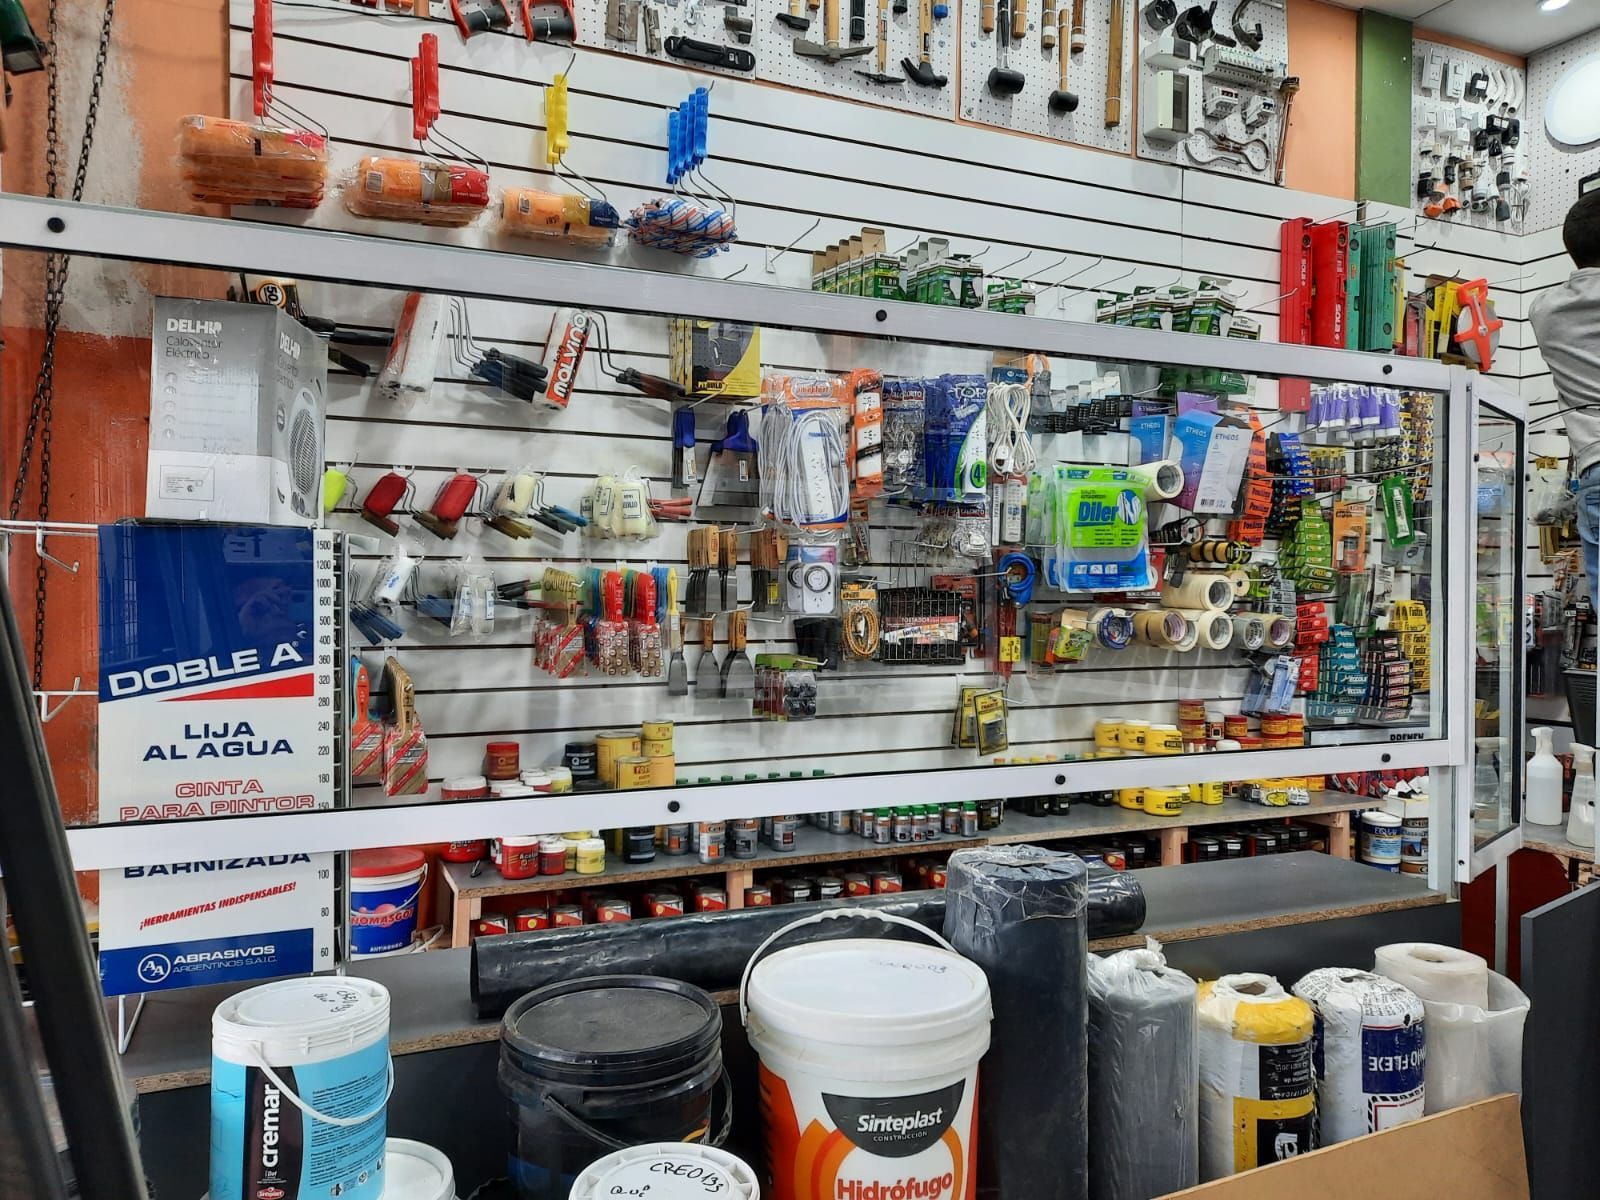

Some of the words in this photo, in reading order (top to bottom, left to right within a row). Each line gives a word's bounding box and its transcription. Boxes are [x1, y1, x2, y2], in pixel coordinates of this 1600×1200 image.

[1215, 433, 1239, 441] ETHEOS
[974, 464, 981, 480] 4
[1078, 502, 1120, 522] Diler
[316, 540, 331, 551] 1500
[316, 560, 331, 570] 1200
[316, 578, 331, 588] 1000
[319, 616, 331, 626] 500
[319, 635, 331, 645] 400
[318, 654, 331, 665] 360
[108, 648, 261, 697] DOBLE
[270, 642, 303, 667] A
[318, 674, 331, 685] 320
[318, 697, 330, 707] 280
[184, 722, 255, 740] LIJA
[318, 721, 330, 731] 240
[143, 745, 187, 762] AL
[196, 739, 293, 760] AGUA
[318, 745, 330, 756] 220
[318, 774, 330, 784] 180
[175, 779, 264, 798] CINTA
[119, 802, 204, 821] PARA
[210, 794, 315, 815] PINTOR
[124, 853, 312, 879] BARNIZADA
[318, 869, 330, 879] 100
[140, 902, 216, 931] ¡HERRAMIENTAS
[219, 881, 297, 908] INDISPENSABLES!
[321, 907, 330, 917] 80
[173, 945, 275, 965] ABRASIVOS
[321, 947, 329, 957] 60
[173, 958, 244, 974] ARGENTINOS
[245, 955, 278, 967] S.A.I.C.
[262, 1084, 281, 1168] cremar
[857, 1107, 943, 1135] Sinteplast
[873, 1130, 928, 1142] CONSTRUCCIÓN
[837, 1172, 953, 1200] Hidrófugo
